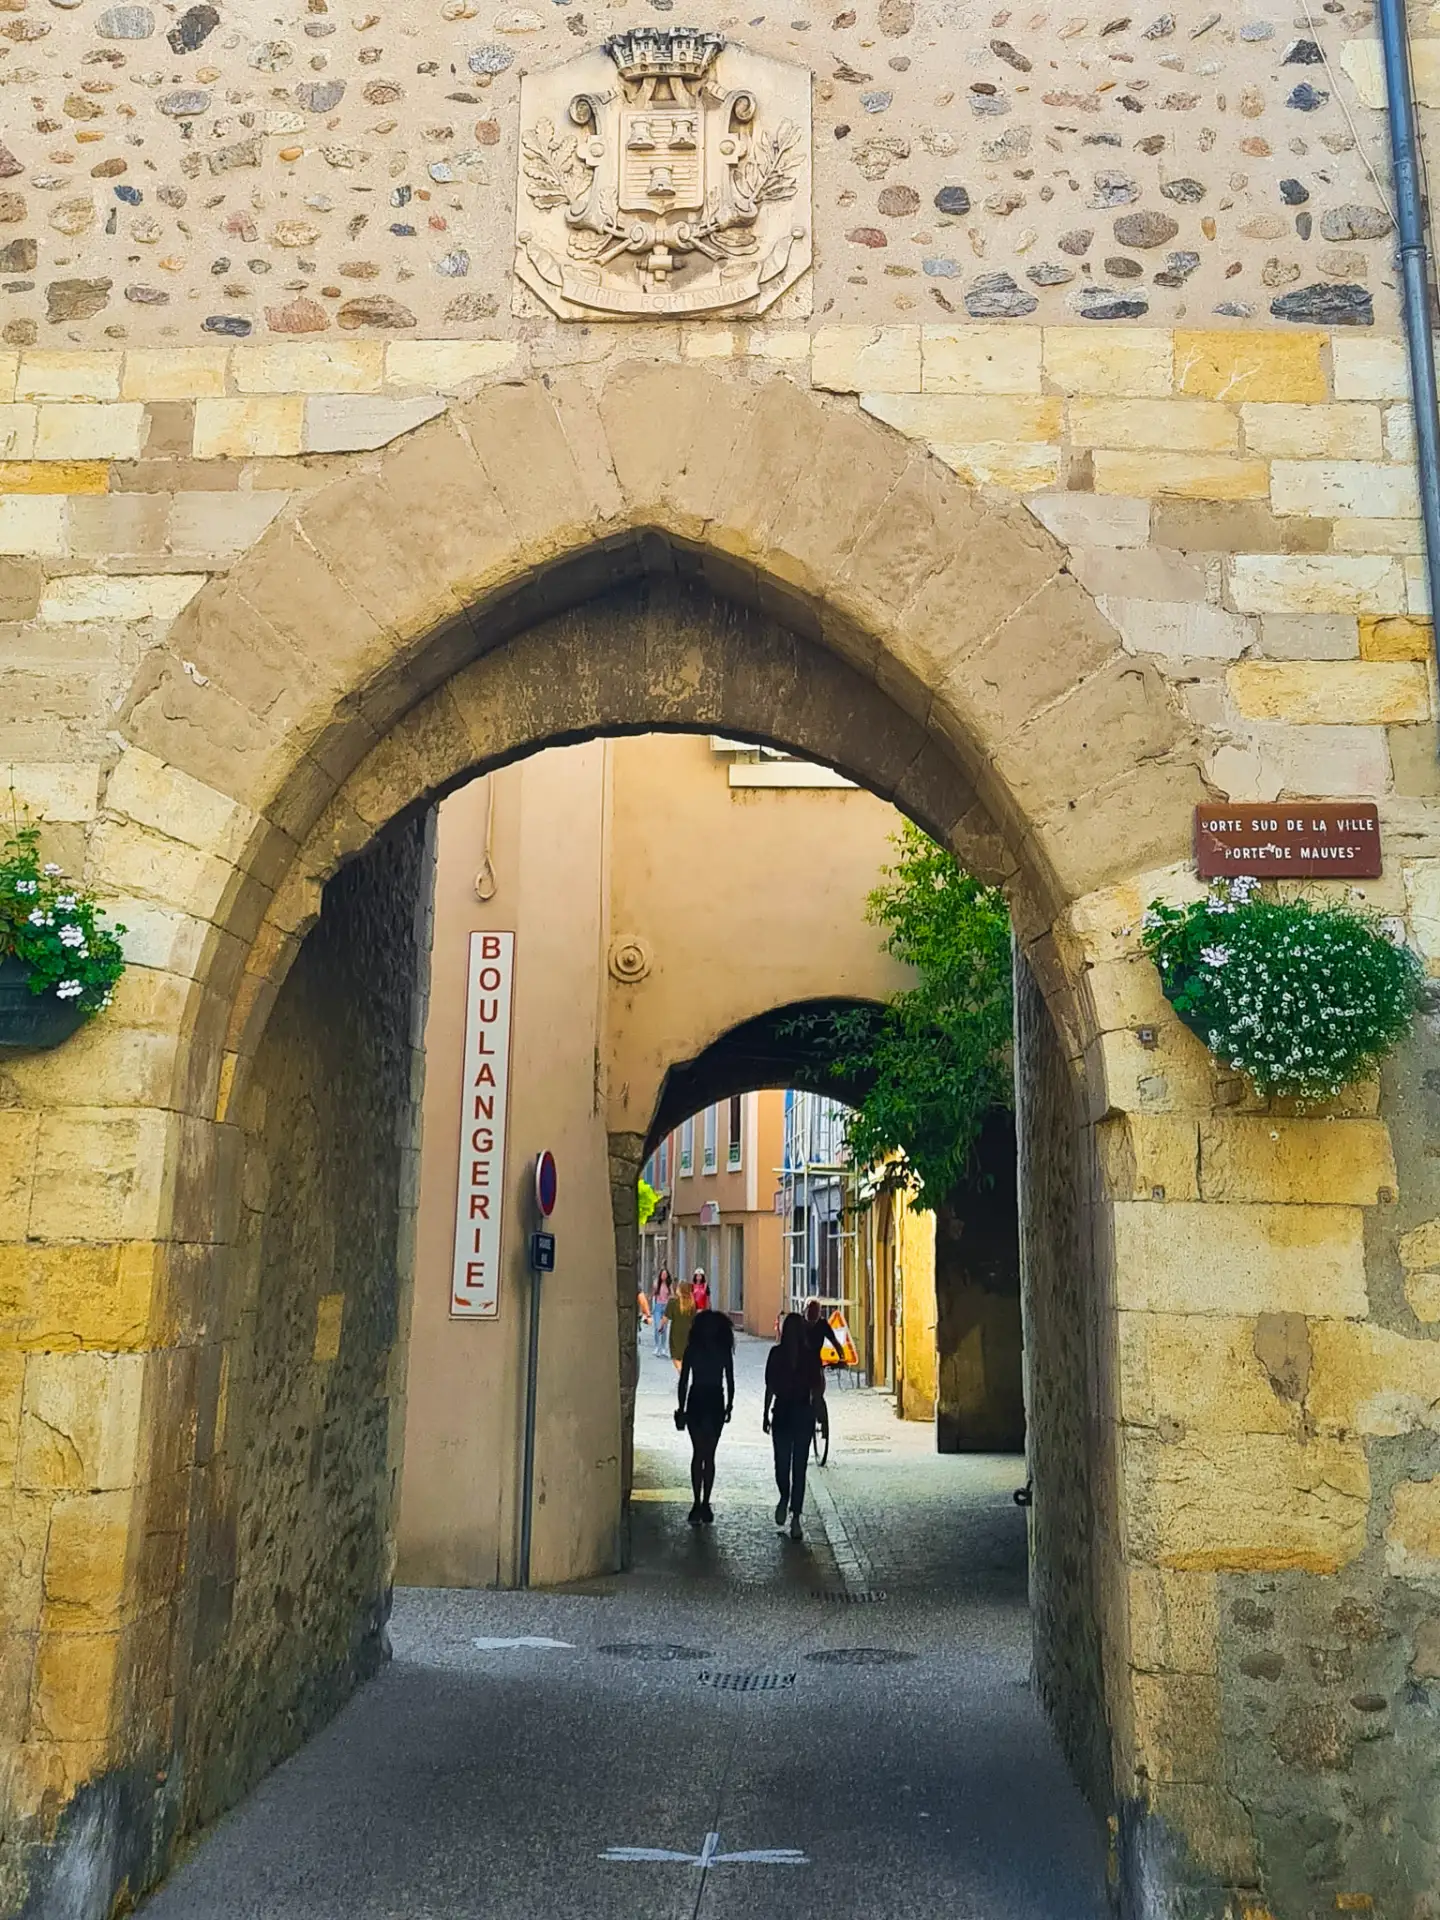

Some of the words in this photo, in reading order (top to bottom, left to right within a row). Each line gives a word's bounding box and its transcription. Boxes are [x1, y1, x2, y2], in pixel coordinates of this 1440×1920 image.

[1252, 820, 1278, 831] SUD
[1286, 819, 1304, 831] DE
[1312, 819, 1327, 831] LA
[1337, 819, 1374, 831] VILLE
[1275, 847, 1292, 859] DE
[465, 935, 502, 1289] BOULANGERIE
